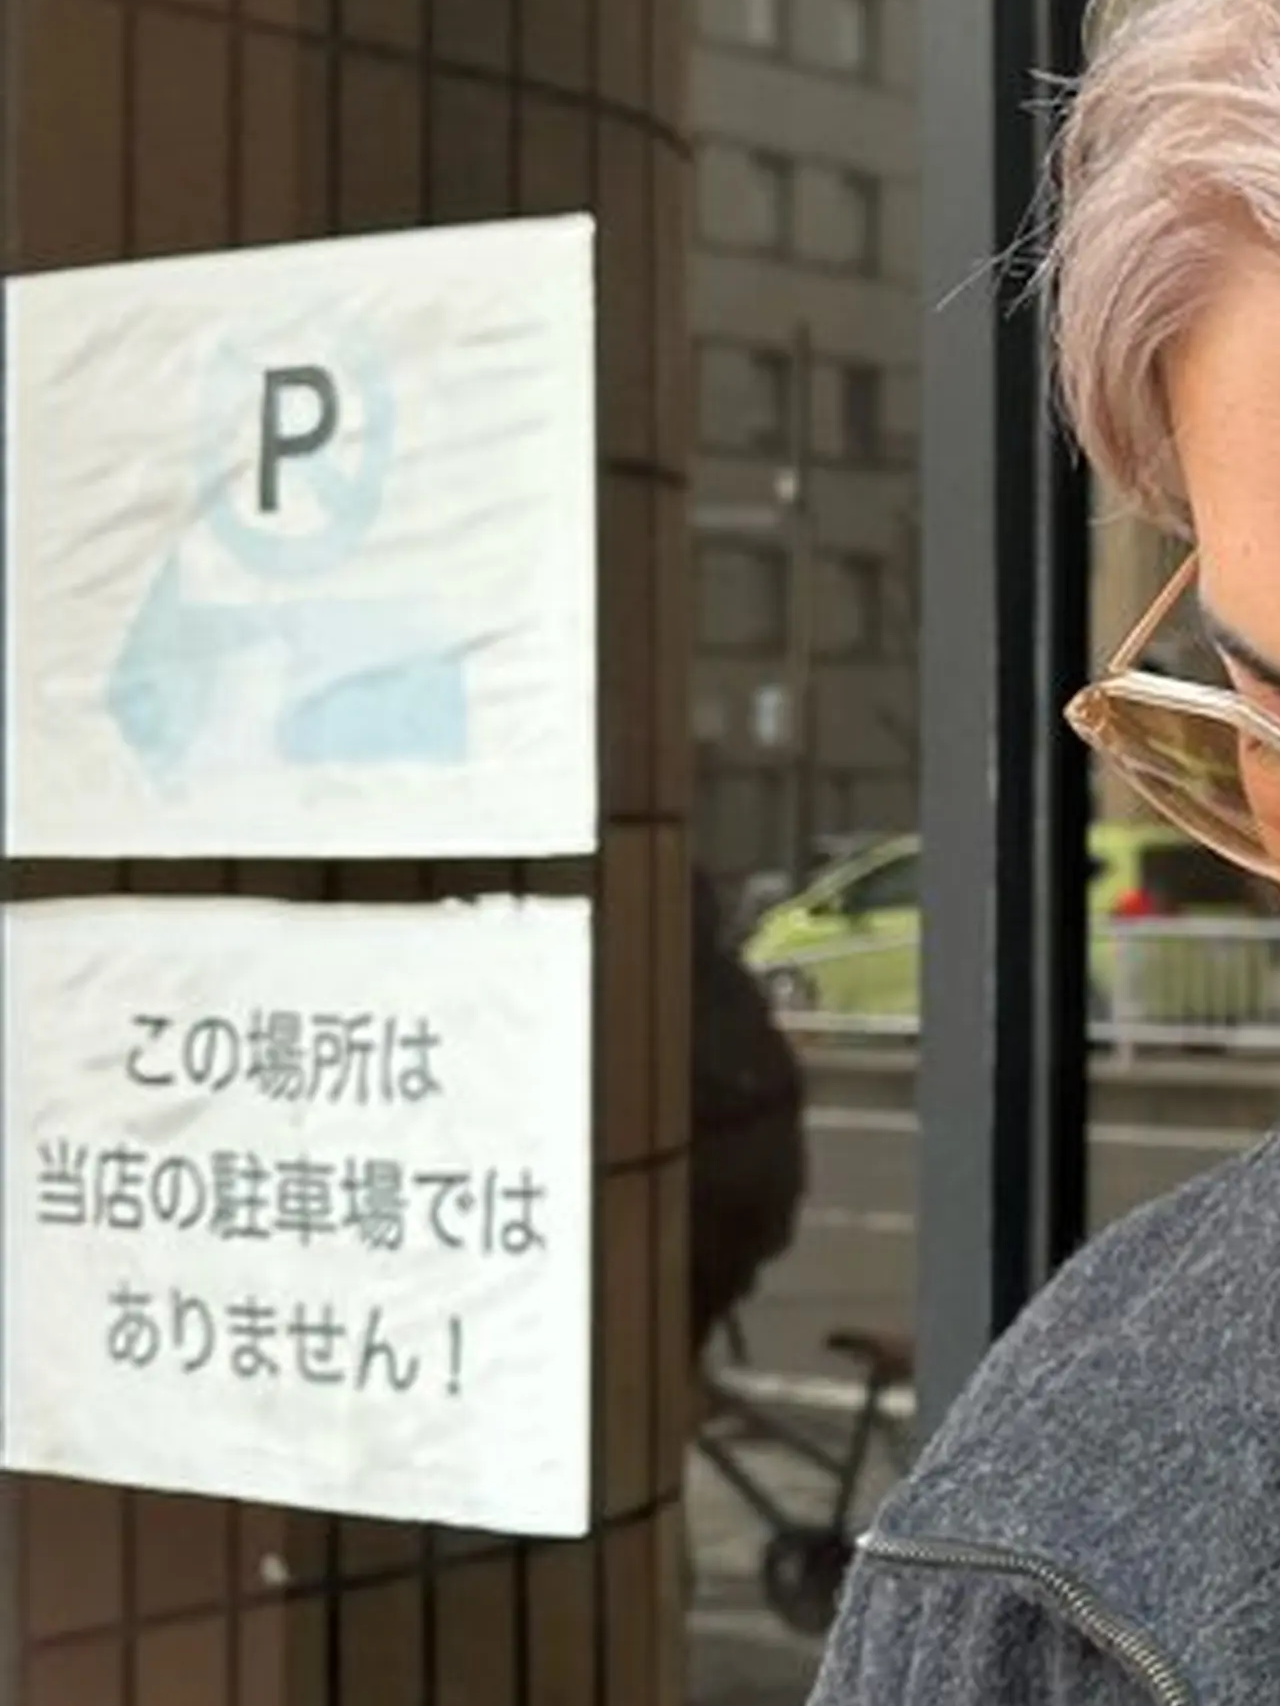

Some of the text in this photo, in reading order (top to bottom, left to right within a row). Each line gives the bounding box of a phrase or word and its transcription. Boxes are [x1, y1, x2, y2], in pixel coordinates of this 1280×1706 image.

[256, 364, 341, 514] P
[126, 1010, 442, 1103] この場所は
[36, 1139, 548, 1257] 当店の駐車場では
[106, 1281, 465, 1396] ありません！
